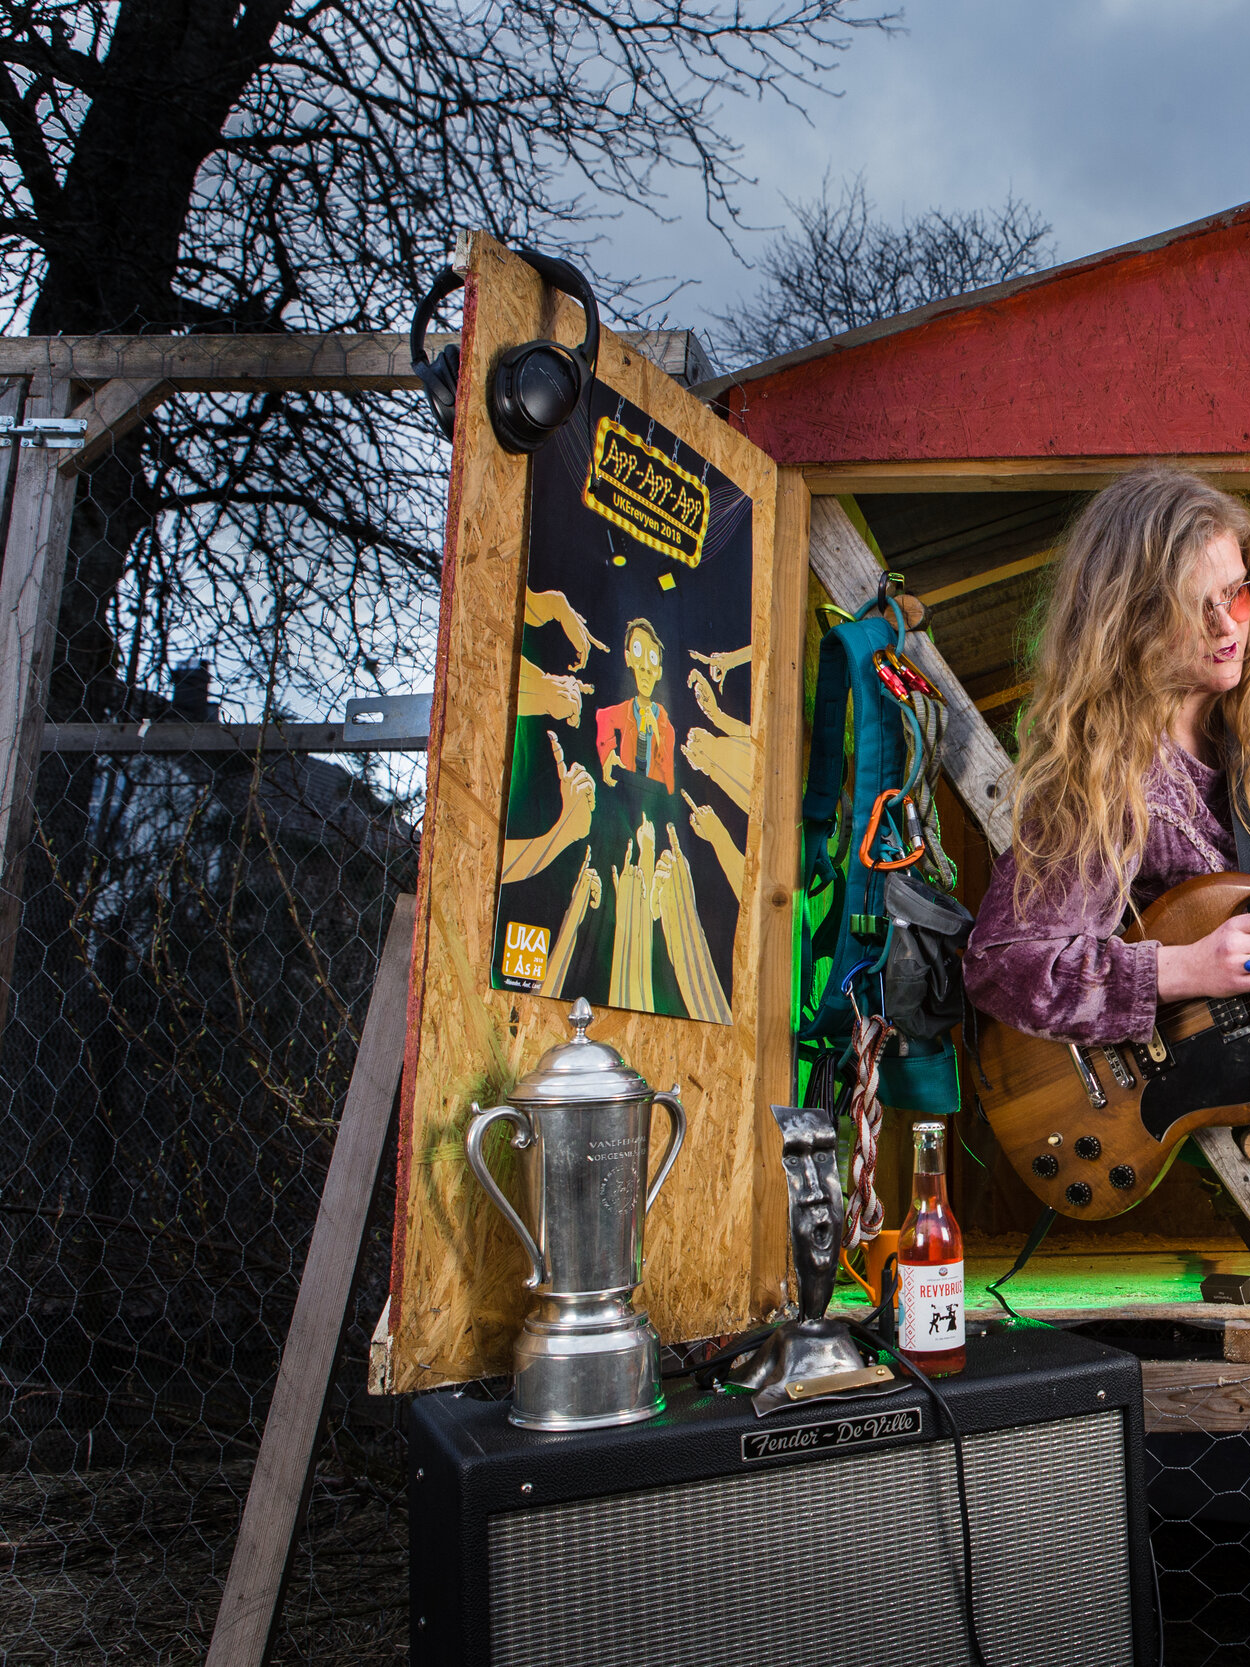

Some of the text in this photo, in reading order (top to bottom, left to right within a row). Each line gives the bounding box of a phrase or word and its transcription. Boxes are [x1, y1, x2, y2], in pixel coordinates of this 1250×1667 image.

[613, 491, 682, 544] UKErevyen 2018
[507, 924, 547, 955] UKA
[513, 954, 531, 976] Ås
[920, 1280, 963, 1298] REVYBRUS
